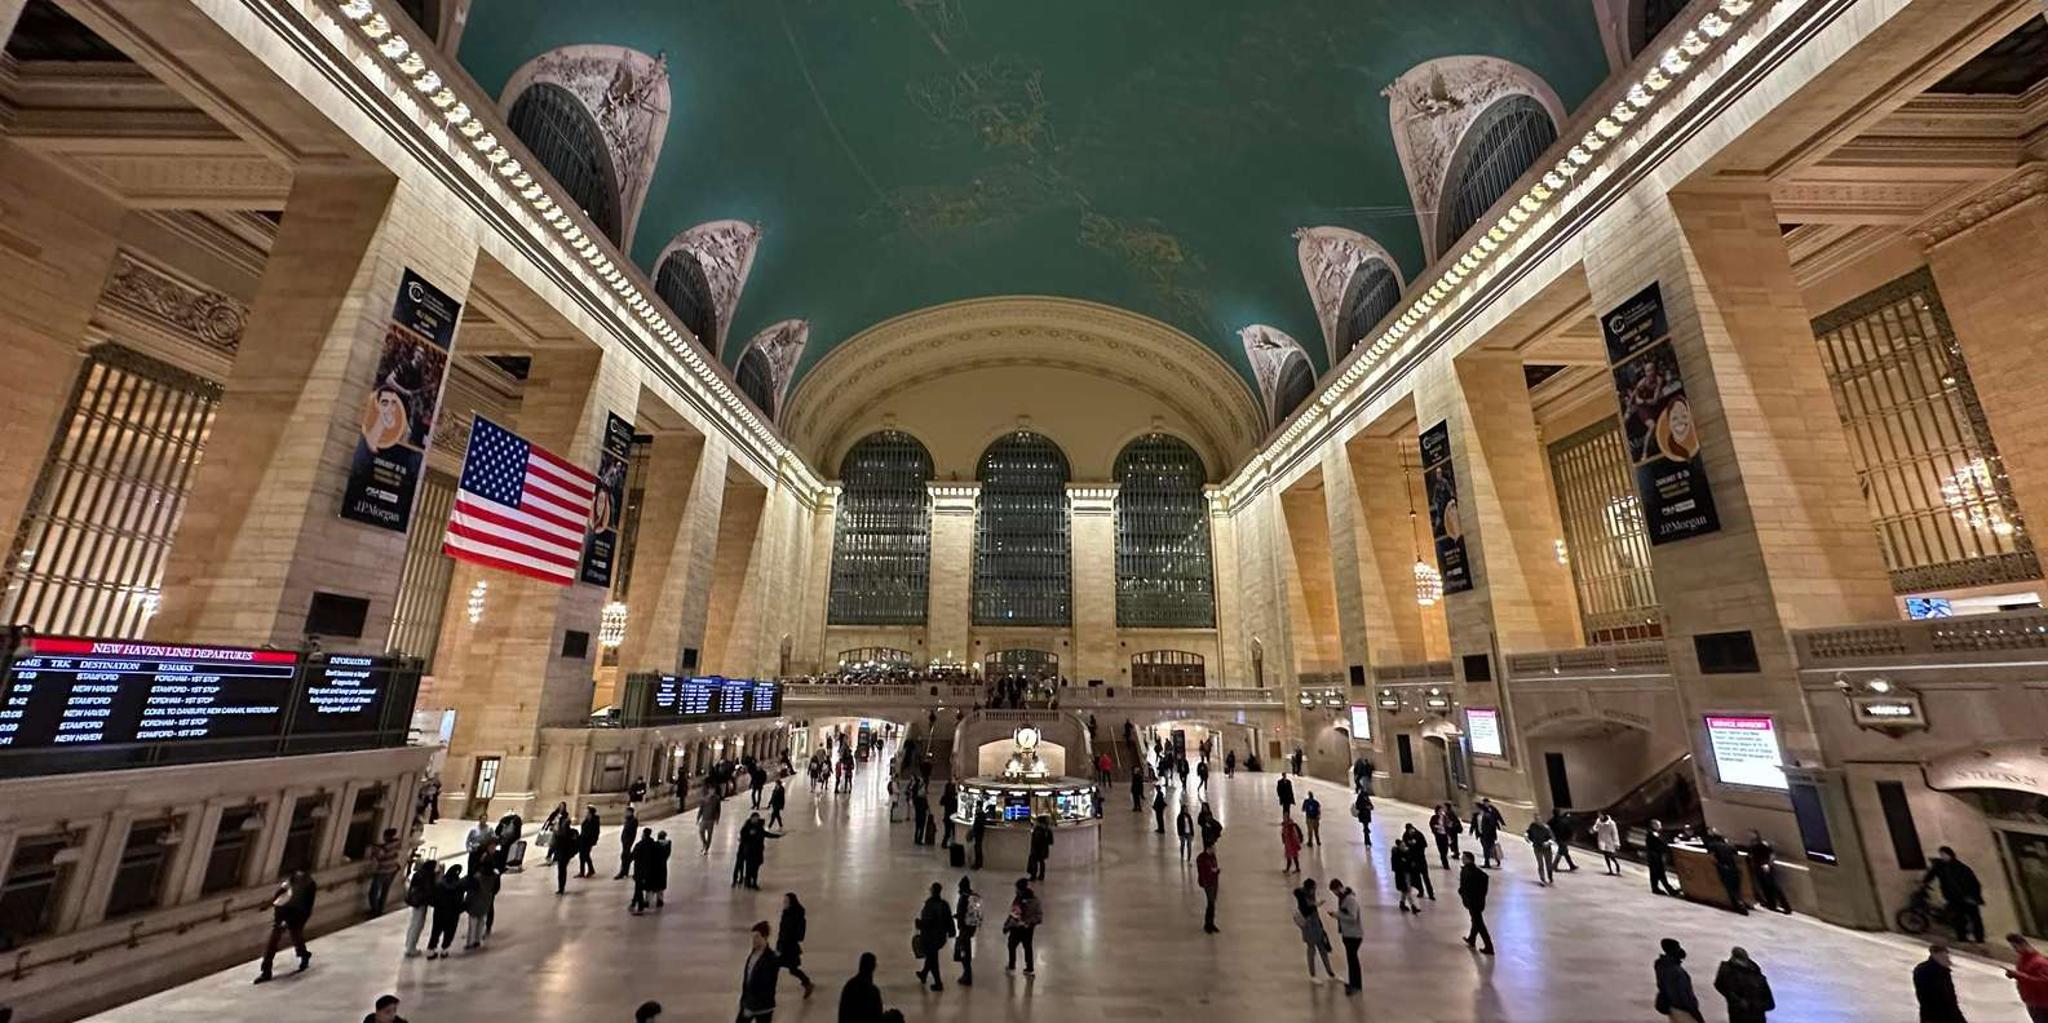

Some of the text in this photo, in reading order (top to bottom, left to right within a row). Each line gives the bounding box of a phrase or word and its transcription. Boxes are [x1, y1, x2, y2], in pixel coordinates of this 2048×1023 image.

[92, 643, 254, 660] NEW HAVEN LINE DEPARTURES
[51, 660, 72, 668] TRK
[80, 660, 140, 670] DESTINATION
[76, 672, 120, 680] STAMFORD
[58, 722, 104, 730] STAMFORD
[54, 734, 76, 742] NEW
[75, 733, 104, 741] HAVEN
[136, 731, 173, 740] STAMFORD
